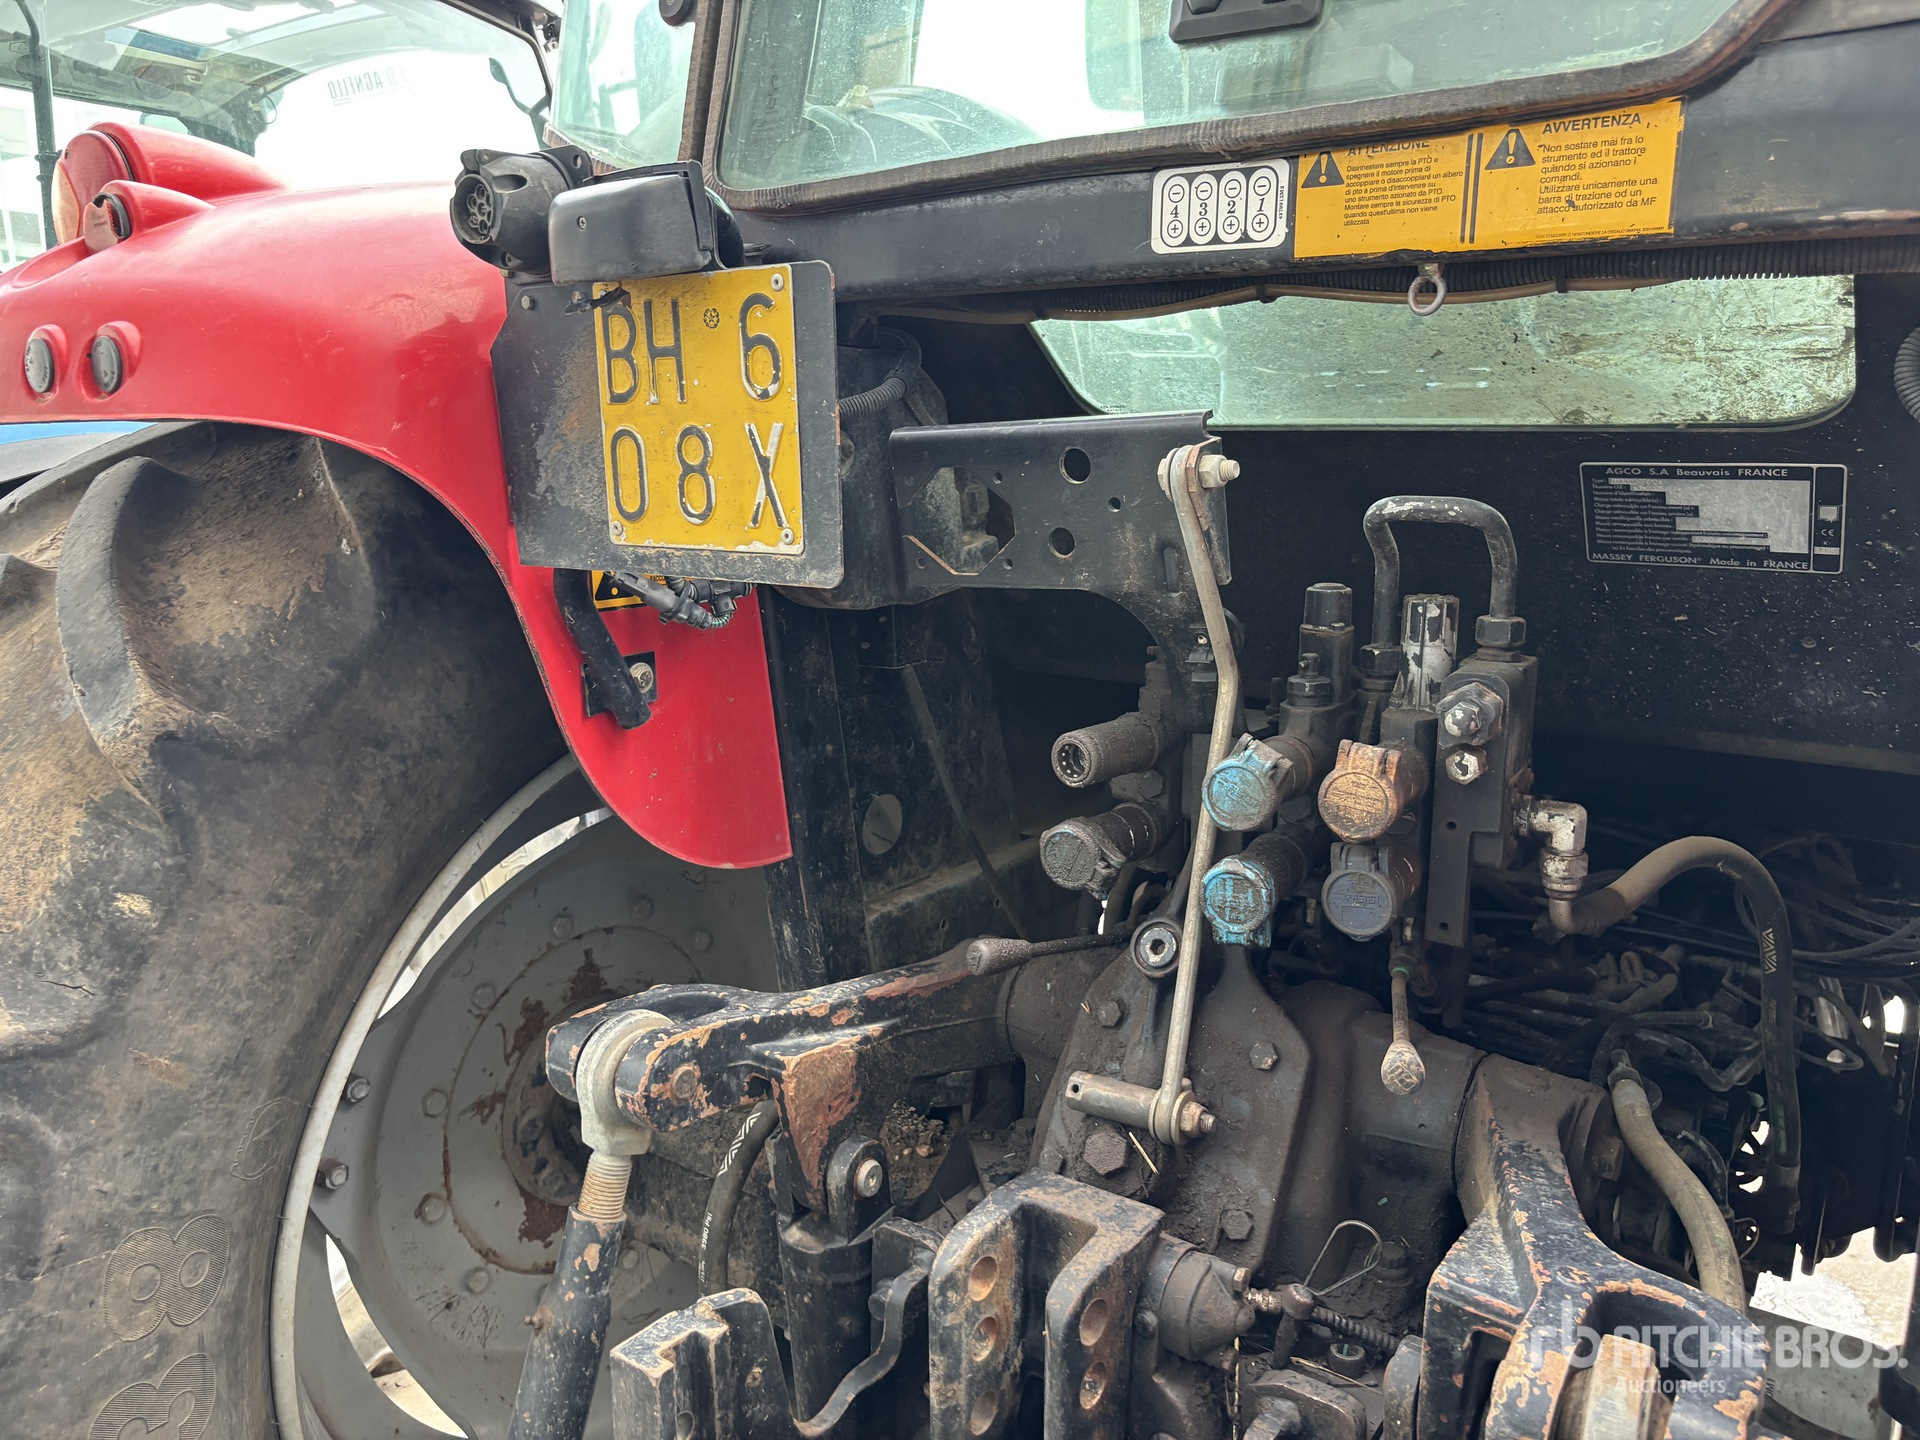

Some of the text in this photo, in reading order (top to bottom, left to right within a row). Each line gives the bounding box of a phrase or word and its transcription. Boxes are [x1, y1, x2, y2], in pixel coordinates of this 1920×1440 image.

[1542, 113, 1641, 134] AVVERTENZA
[1348, 141, 1429, 156] ATTENZIONE
[1543, 144, 1561, 153] Non
[1564, 141, 1598, 151] sostare
[1601, 137, 1617, 147] mai
[1621, 136, 1632, 145] fra
[1542, 147, 1645, 163] strumento ed il trattore
[1346, 171, 1374, 180] spegnere
[1405, 167, 1422, 175] prima
[1347, 163, 1384, 172] Disinnestare
[1541, 164, 1575, 175] quando
[1578, 162, 1586, 170] si
[1589, 158, 1631, 169] azionano
[1346, 180, 1379, 188] accoppiare
[1353, 188, 1362, 196] pto
[1370, 186, 1387, 195] prima
[1540, 183, 1579, 194] Utilizzare
[1583, 179, 1636, 190] unicamente
[1344, 202, 1369, 210] Montare
[1371, 200, 1394, 209] sempre
[1402, 196, 1432, 205] sicurezza
[1358, 193, 1388, 202] strumento
[1390, 191, 1416, 199] azionato
[1539, 196, 1561, 204] barra
[1575, 191, 1612, 200] trazione
[1615, 189, 1627, 197] od
[1170, 198, 1265, 218] 4 3 2 1
[1537, 197, 1657, 214] attacco autorizzato da MF
[1344, 211, 1367, 219] quando
[603, 292, 784, 404] BH 6
[1606, 467, 1642, 475] AGCO
[1676, 468, 1730, 476] Beauvais
[1738, 468, 1788, 477] FRANCE
[1592, 553, 1632, 561] MASSEY
[1709, 558, 1740, 567] Made
[1746, 559, 1757, 567] in
[1763, 560, 1808, 569] FRANCE
